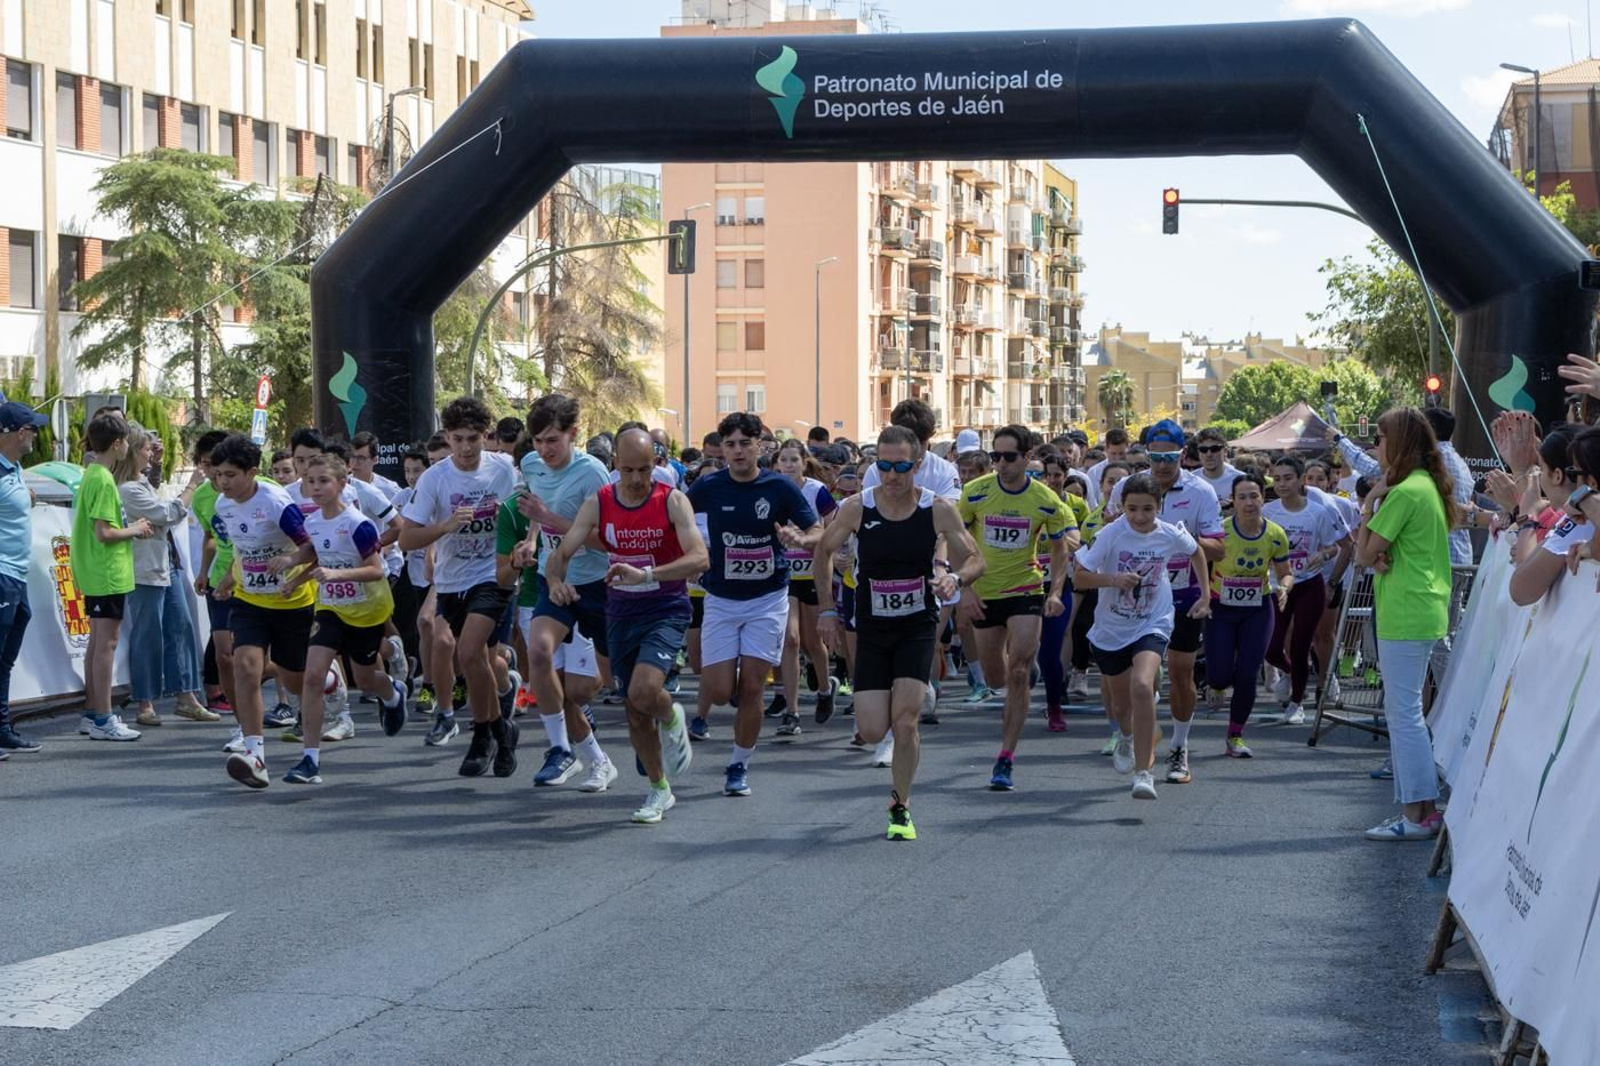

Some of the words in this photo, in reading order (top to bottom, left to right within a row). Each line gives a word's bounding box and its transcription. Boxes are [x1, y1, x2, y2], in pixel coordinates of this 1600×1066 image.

[814, 74, 916, 93] Patronato
[924, 71, 1028, 93] Municipal
[1035, 70, 1063, 88] de
[814, 98, 911, 121] Deportes
[918, 97, 945, 115] de
[952, 95, 1004, 115] Jaén
[459, 517, 494, 534] 208
[994, 528, 1020, 542] 119
[731, 560, 768, 574] 293
[247, 572, 280, 587] 244
[1169, 570, 1180, 583] 7
[880, 593, 915, 609] 184
[1227, 587, 1257, 601] 109
